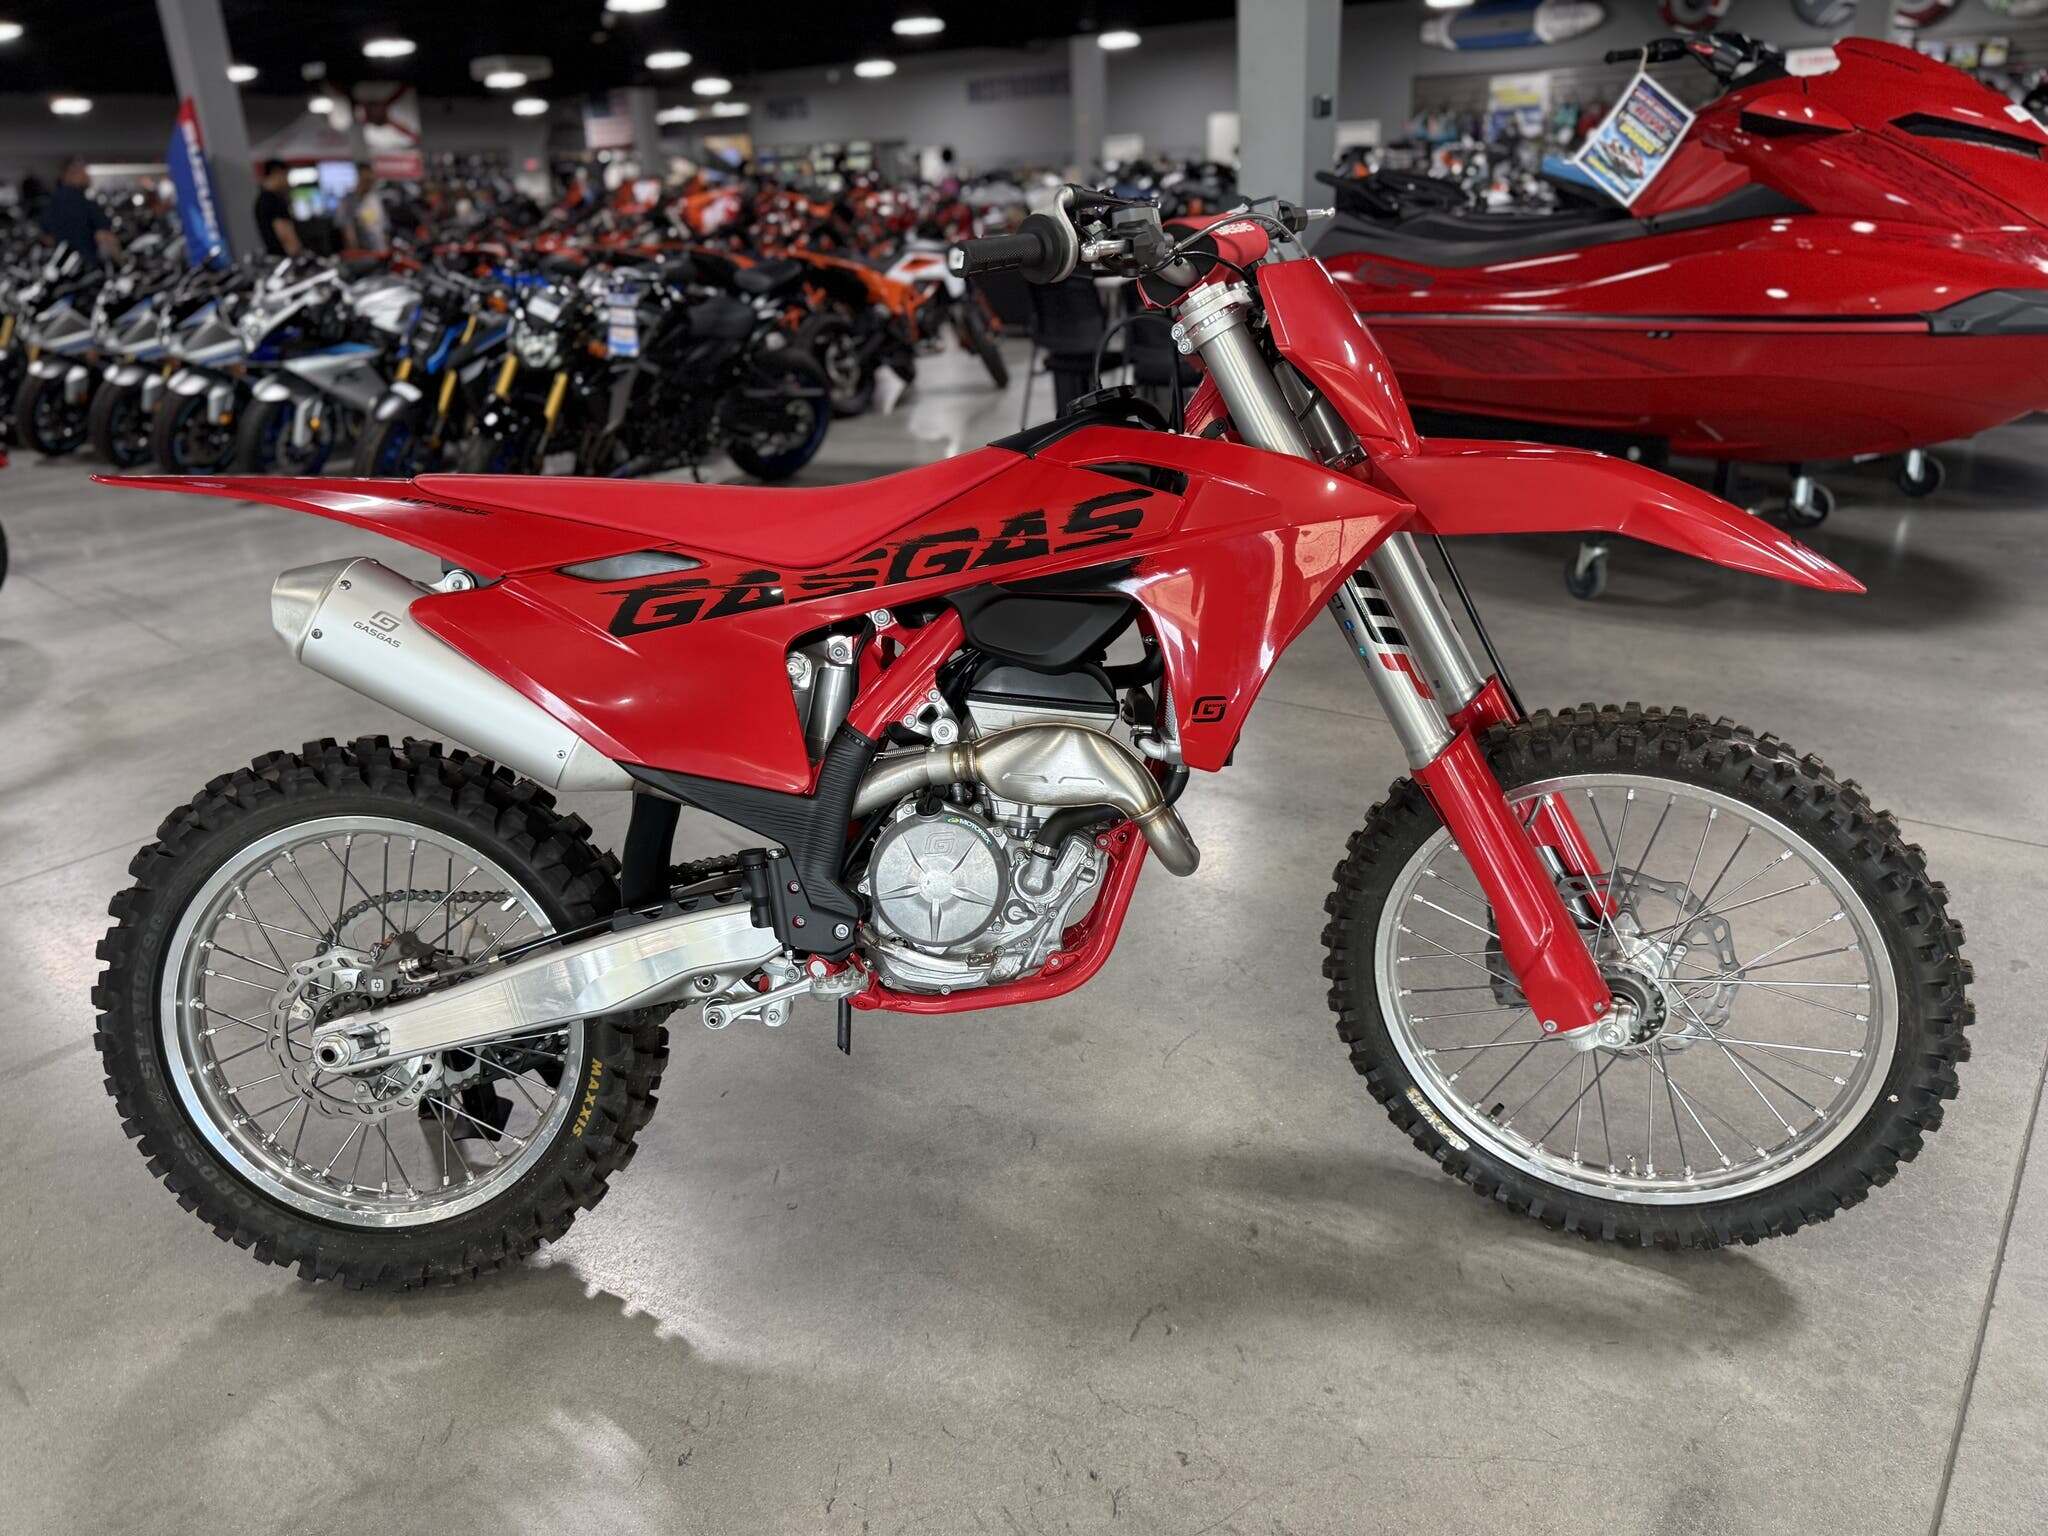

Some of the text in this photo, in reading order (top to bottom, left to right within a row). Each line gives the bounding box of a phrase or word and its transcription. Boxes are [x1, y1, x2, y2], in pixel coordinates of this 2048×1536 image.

[598, 489, 1155, 637] GASGAS
[353, 620, 402, 649] GASGAS
[959, 818, 993, 846] MOTOREX
[572, 1057, 603, 1137] MAXXIS
